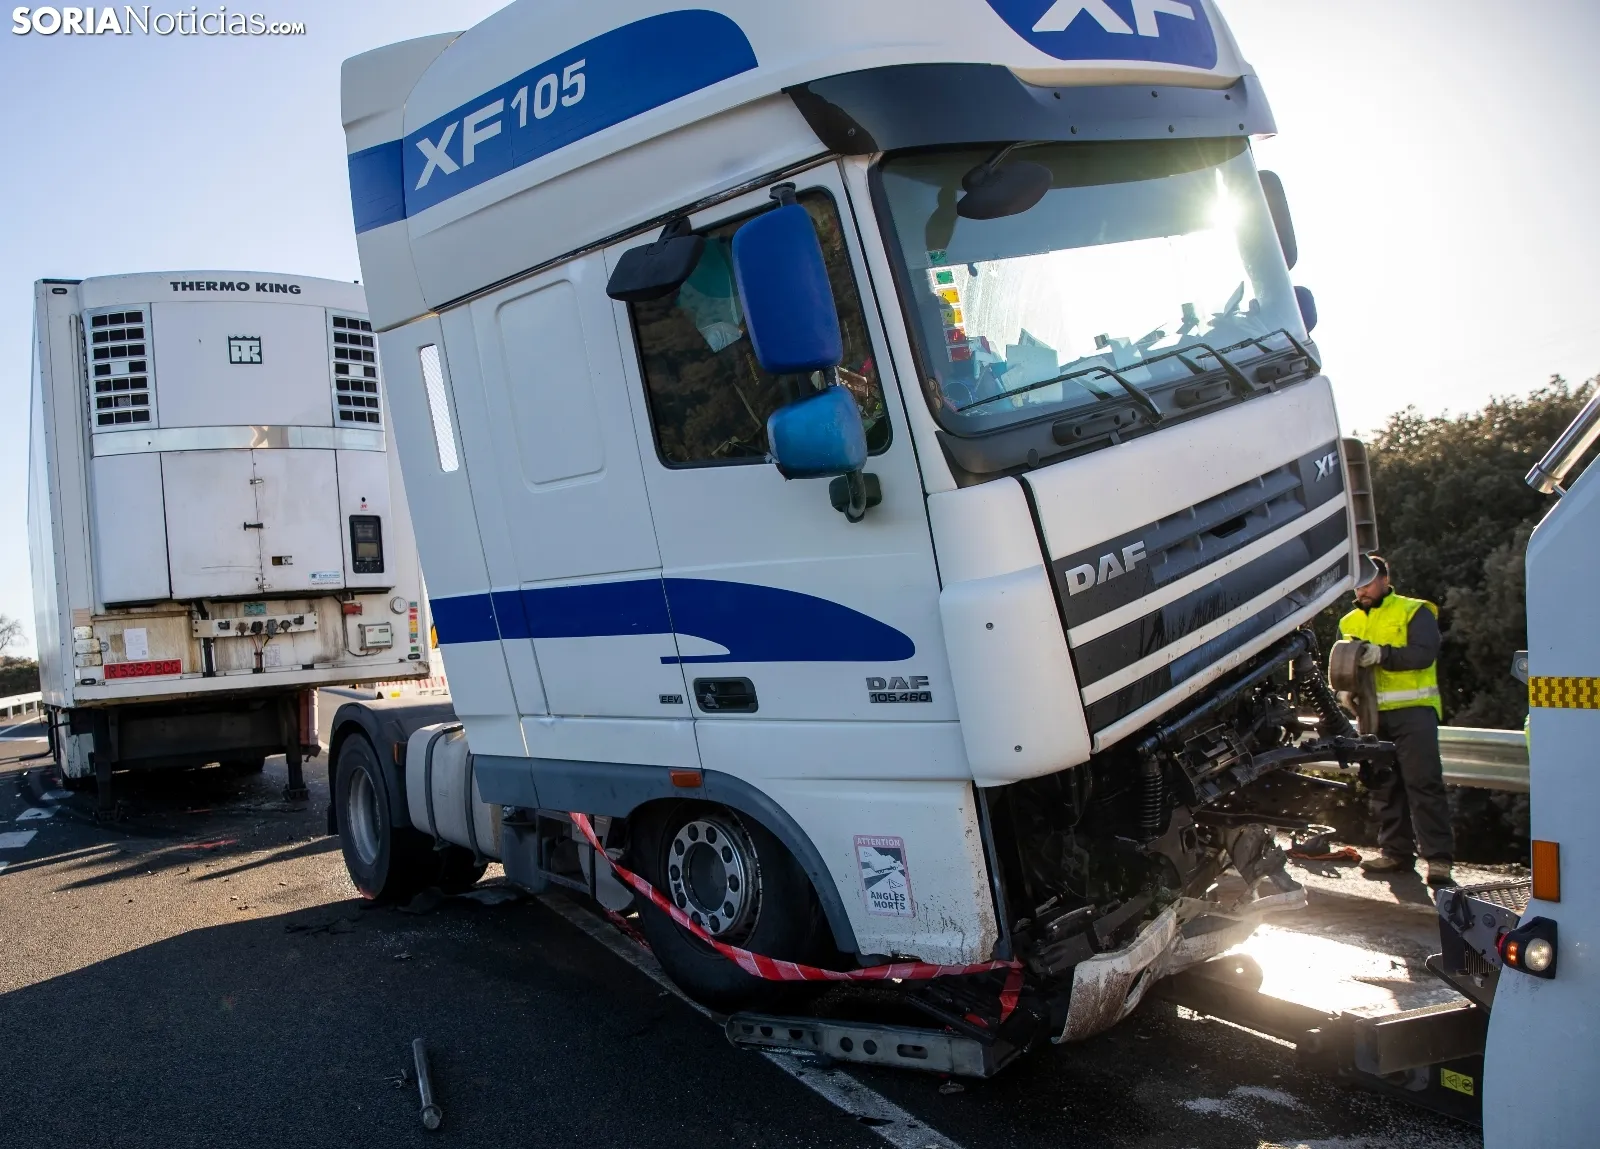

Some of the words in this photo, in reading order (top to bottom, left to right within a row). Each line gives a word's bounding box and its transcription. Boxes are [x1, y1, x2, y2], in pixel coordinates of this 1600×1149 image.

[415, 98, 504, 191] XF
[510, 58, 586, 129] 105
[170, 281, 250, 292] THERMO
[255, 282, 302, 295] KING
[1313, 450, 1338, 483] XF
[1064, 540, 1147, 597] DAF
[866, 675, 930, 691] DAF
[661, 695, 681, 703] EEV
[870, 692, 930, 703] 105.460
[856, 837, 902, 847] ATTENTION
[870, 891, 906, 902] ANGLES
[873, 900, 906, 911] MORTS
